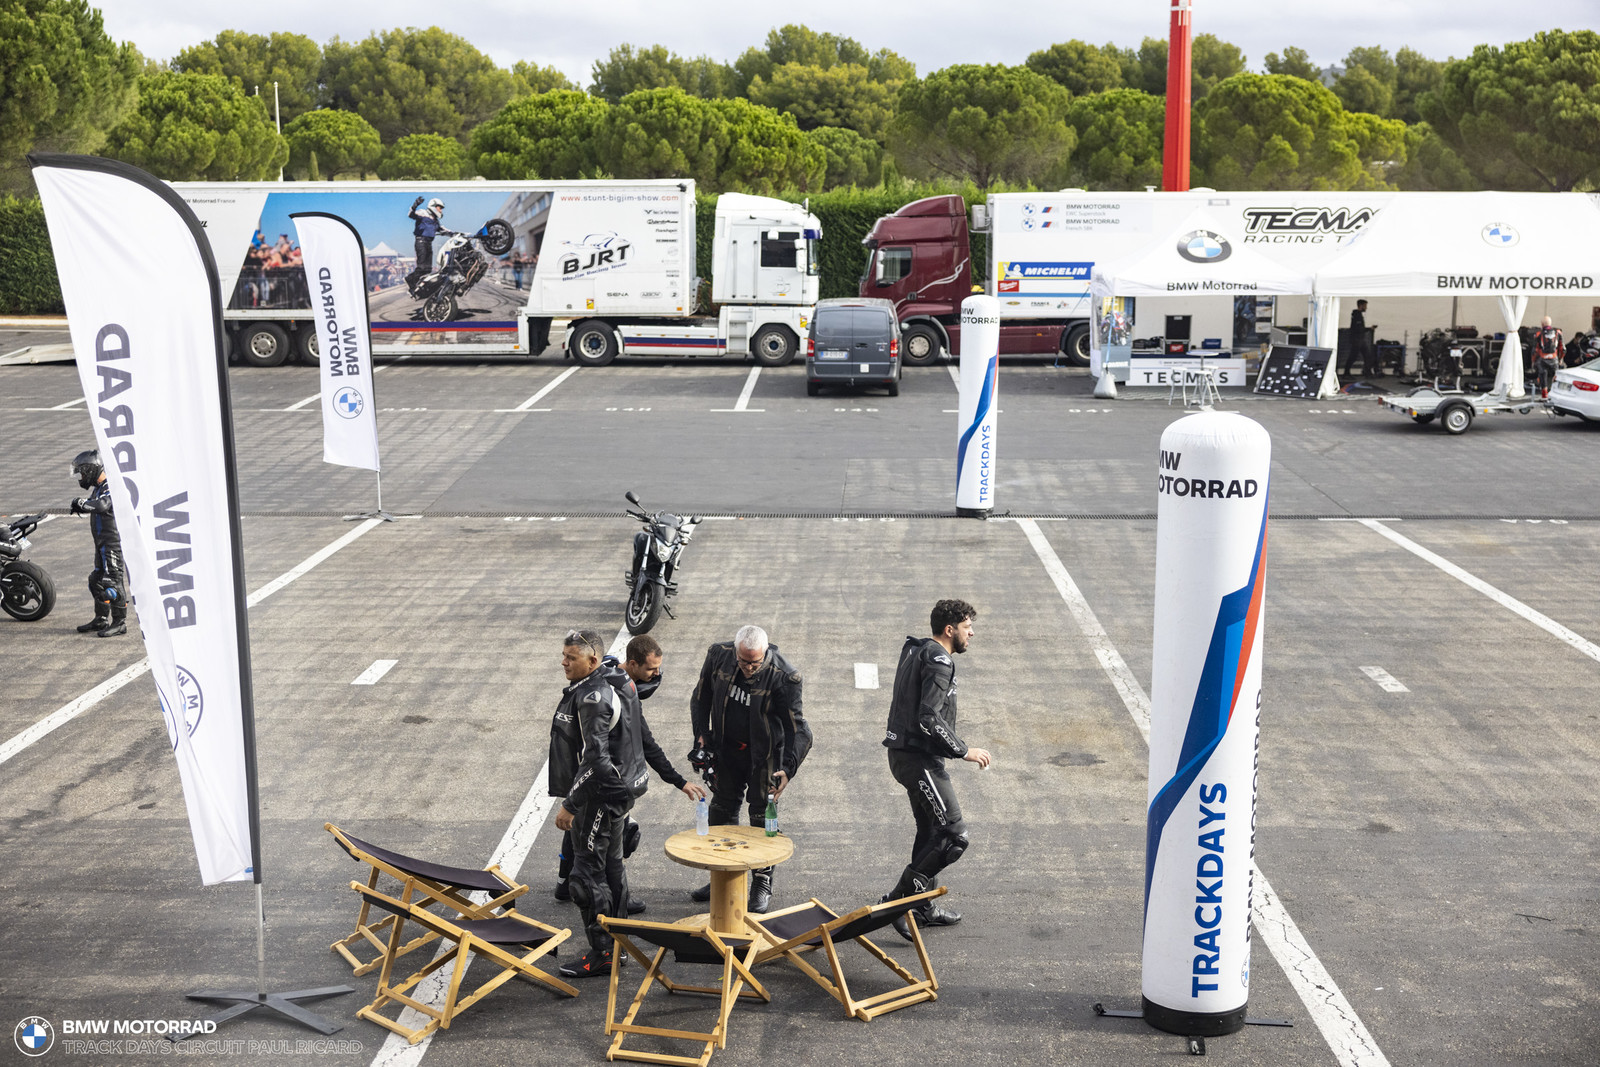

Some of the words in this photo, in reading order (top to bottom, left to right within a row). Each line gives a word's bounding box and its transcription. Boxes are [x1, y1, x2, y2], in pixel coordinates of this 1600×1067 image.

[560, 194, 679, 203] www.stunt-bigjim-show.com
[1245, 208, 1373, 231] TECMA
[1243, 235, 1324, 243] RACING
[563, 244, 631, 275] BJRT
[1024, 267, 1088, 276] MICHELIN
[1167, 282, 1199, 291] BMW
[1202, 280, 1258, 291] Motorrad
[1437, 275, 1484, 289] BMW
[1489, 276, 1594, 290] MOTORRAD
[961, 307, 974, 315] MW
[961, 316, 998, 324] OTORRAD
[1143, 371, 1229, 384] TECMS
[979, 424, 991, 504] TRACKDAYS
[1159, 450, 1182, 471] MW
[1158, 474, 1258, 499] OTORRAD
[1191, 782, 1228, 998] TRACKDAYS
